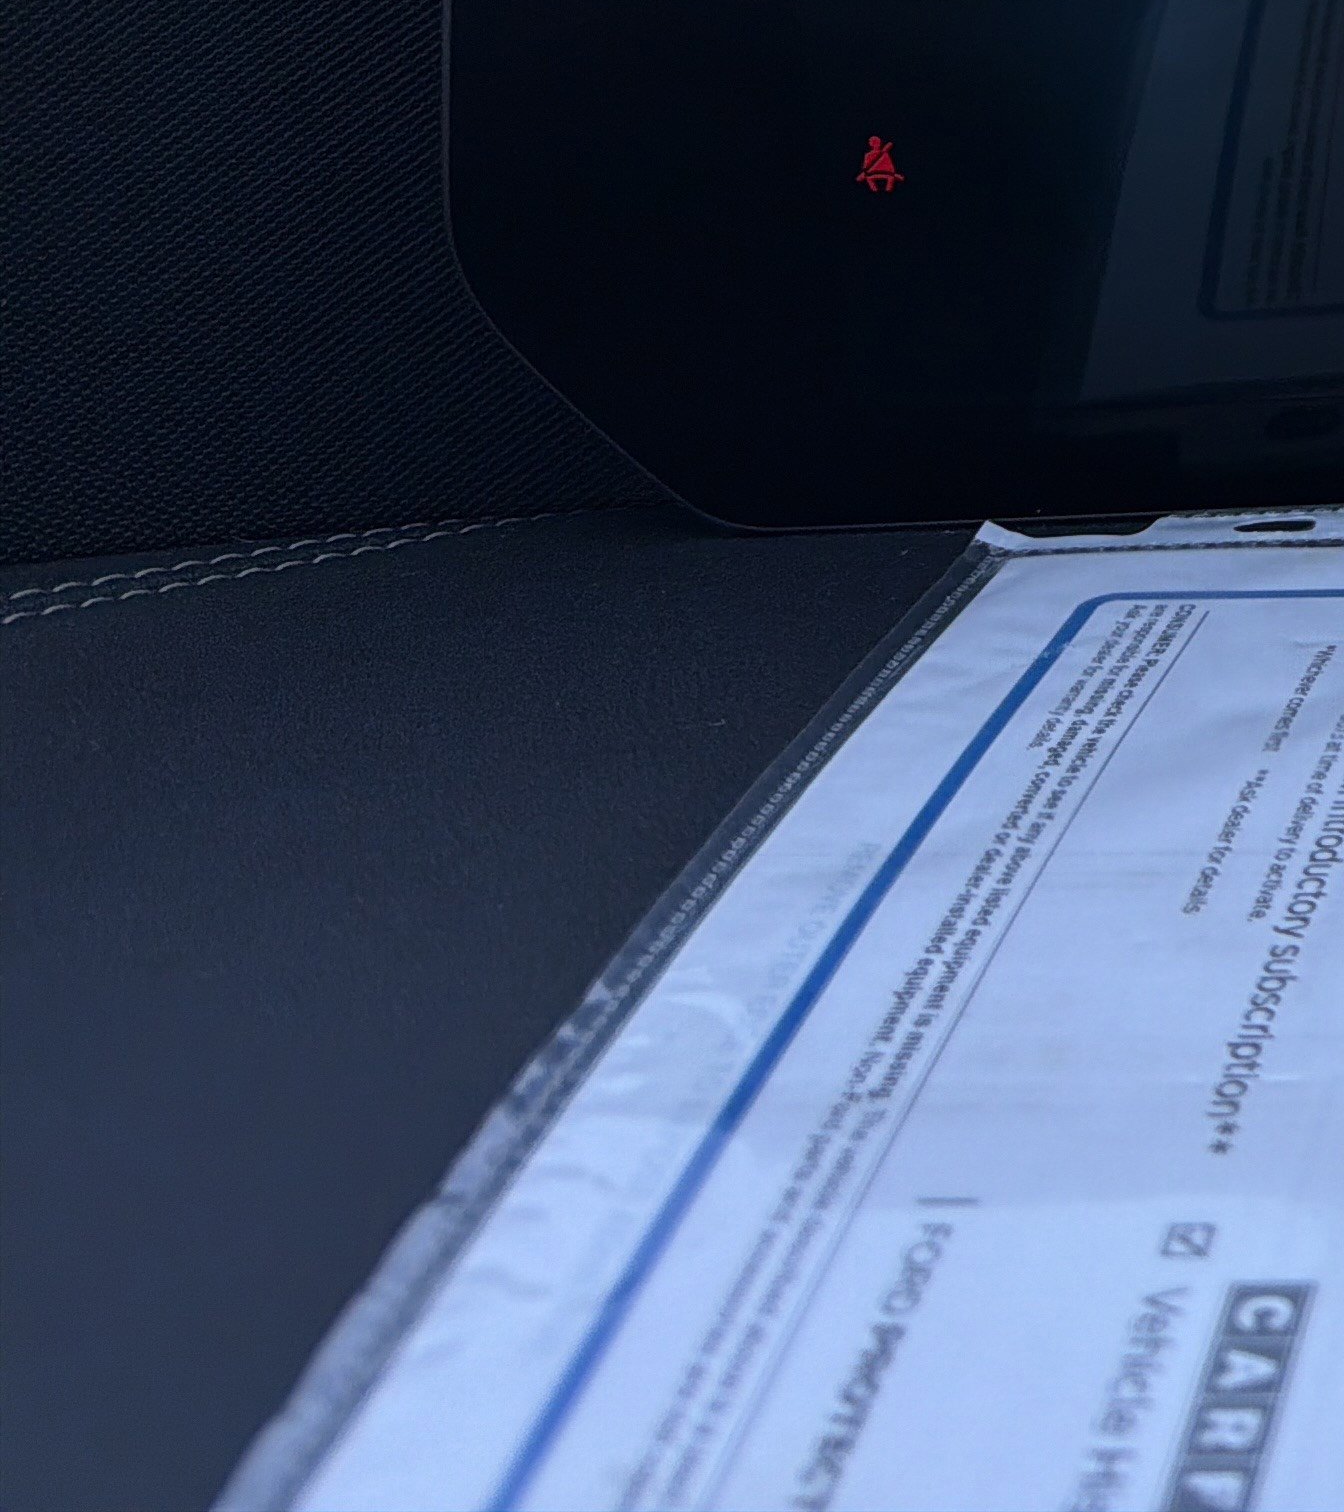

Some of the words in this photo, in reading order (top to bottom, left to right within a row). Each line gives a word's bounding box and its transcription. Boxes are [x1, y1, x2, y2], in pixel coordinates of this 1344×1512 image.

[1123, 604, 1148, 619] Ask
[1109, 620, 1132, 639] your
[1090, 639, 1121, 665] dealer
[1080, 665, 1104, 678] for
[1106, 664, 1130, 677] for
[1123, 658, 1160, 688] Please
[1049, 679, 1089, 716] warranty
[1074, 678, 1117, 717] missing,
[1103, 689, 1135, 718] check
[1091, 718, 1117, 735] the
[1273, 697, 1306, 730] comes
[1026, 717, 1063, 750] details.
[1037, 719, 1089, 769] damaged,
[1324, 741, 1344, 753] at
[1065, 736, 1102, 774] vehicle
[1310, 754, 1339, 781] time
[1056, 774, 1080, 788] to
[1304, 782, 1326, 795] of
[1000, 771, 1052, 830] converted
[1042, 789, 1069, 810] see
[1017, 821, 1048, 844] any
[1217, 804, 1251, 844] dealer
[1279, 796, 1319, 845] delivery
[991, 831, 1013, 846] or
[995, 846, 1033, 885] above
[1206, 845, 1233, 865] for
[1273, 847, 1297, 862] to
[924, 848, 1003, 954] dealer-installed
[1181, 866, 1221, 914] details
[1246, 863, 1288, 922] activate.
[970, 887, 1011, 927] listed
[923, 928, 983, 1010] equipment
[870, 958, 935, 1045] equipment.
[1098, 1288, 1186, 1436] Vehicle
